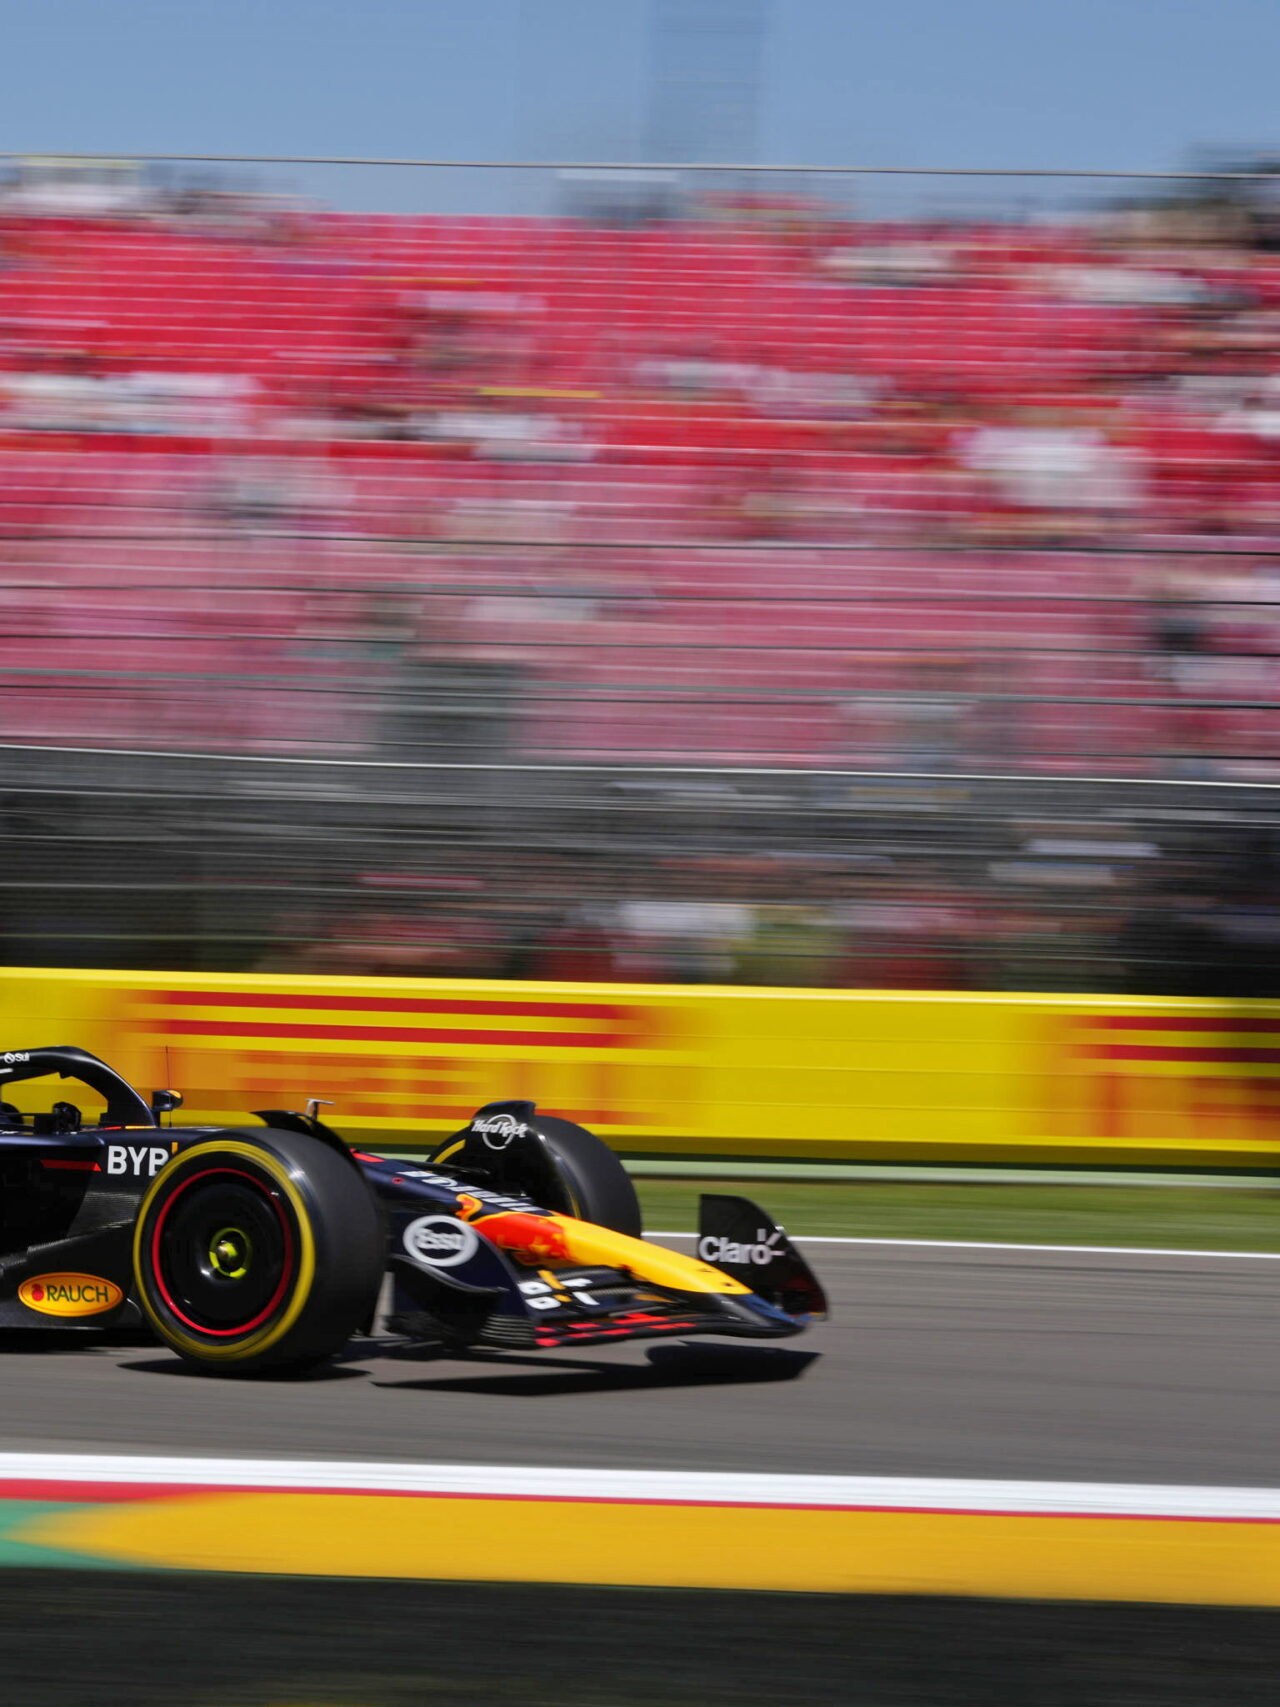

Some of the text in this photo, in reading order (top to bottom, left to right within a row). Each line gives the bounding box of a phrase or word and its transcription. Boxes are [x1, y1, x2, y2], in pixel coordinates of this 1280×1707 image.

[471, 1119, 503, 1134] Hard
[699, 1236, 773, 1265] Claro
[47, 1284, 109, 1303] RAUCH
